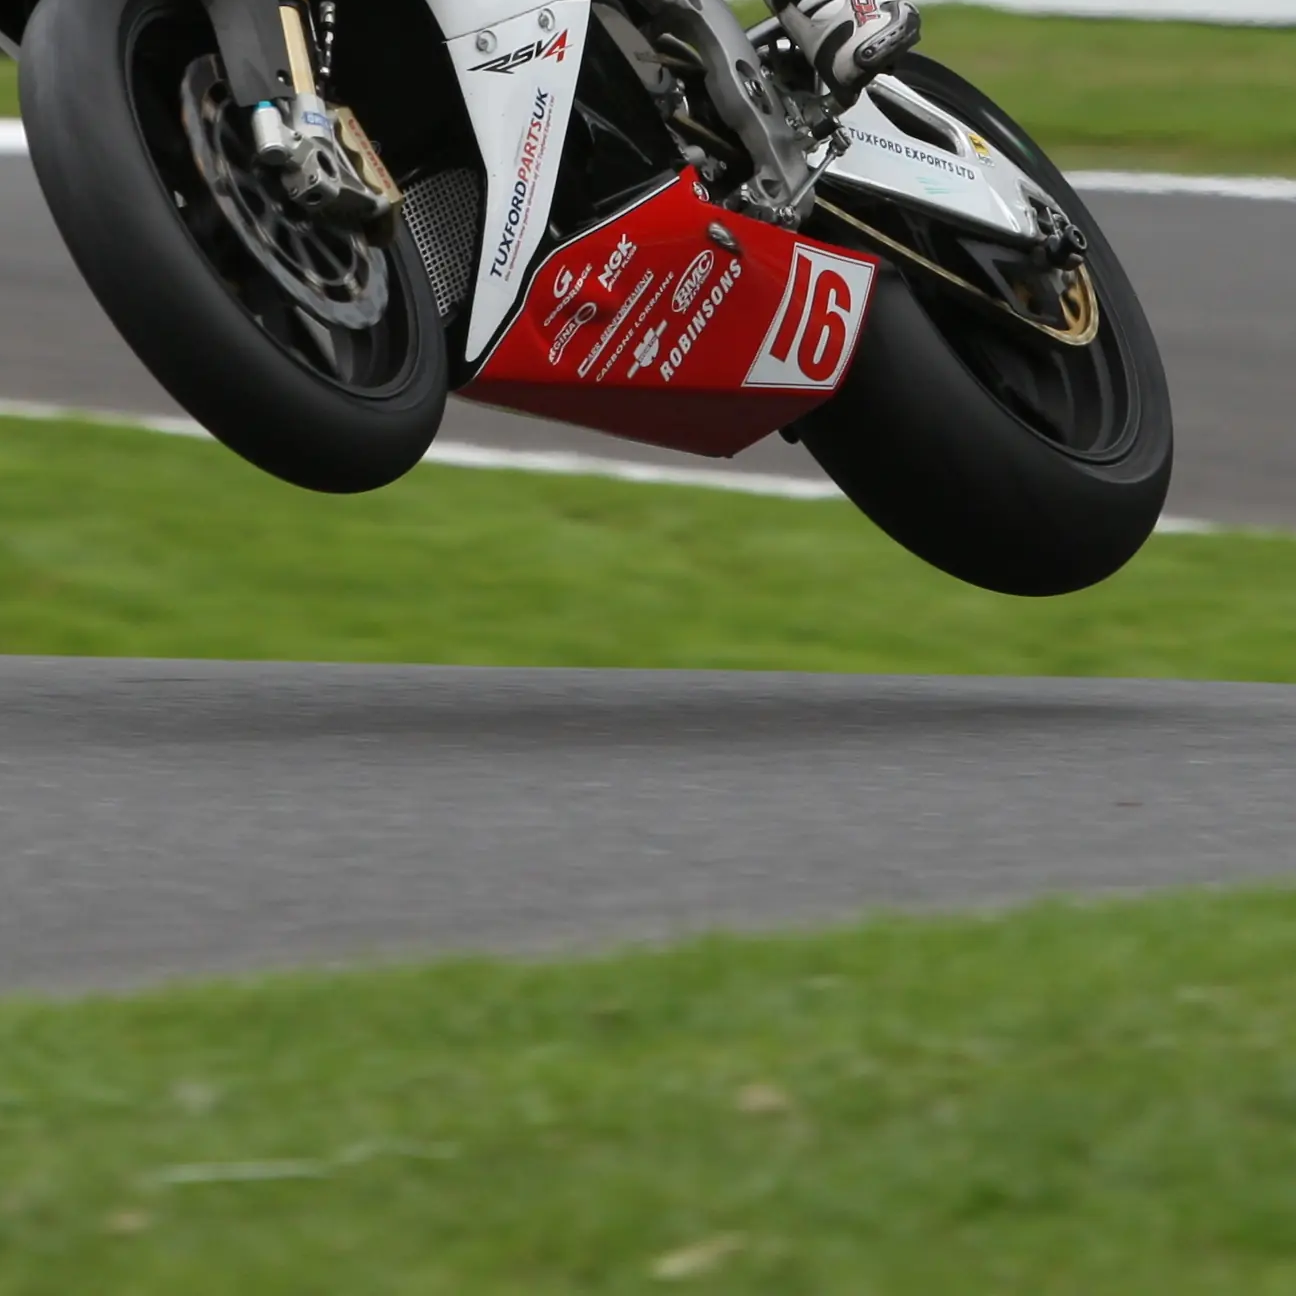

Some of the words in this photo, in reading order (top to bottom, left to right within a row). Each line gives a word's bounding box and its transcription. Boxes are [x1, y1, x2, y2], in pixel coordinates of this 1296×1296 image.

[490, 86, 549, 280] TUXFORDPARTSUK
[849, 128, 903, 154] TUXFORD
[905, 147, 954, 174] EXPORTS
[955, 163, 976, 181] LTD
[544, 263, 592, 326] GOODRIDGE
[597, 233, 632, 288] NGK
[676, 254, 710, 306] BMC
[596, 329, 635, 382] CARBONE
[634, 271, 674, 328] LORRAINE
[660, 258, 741, 382] ROBINSONS
[770, 255, 852, 382] 16
